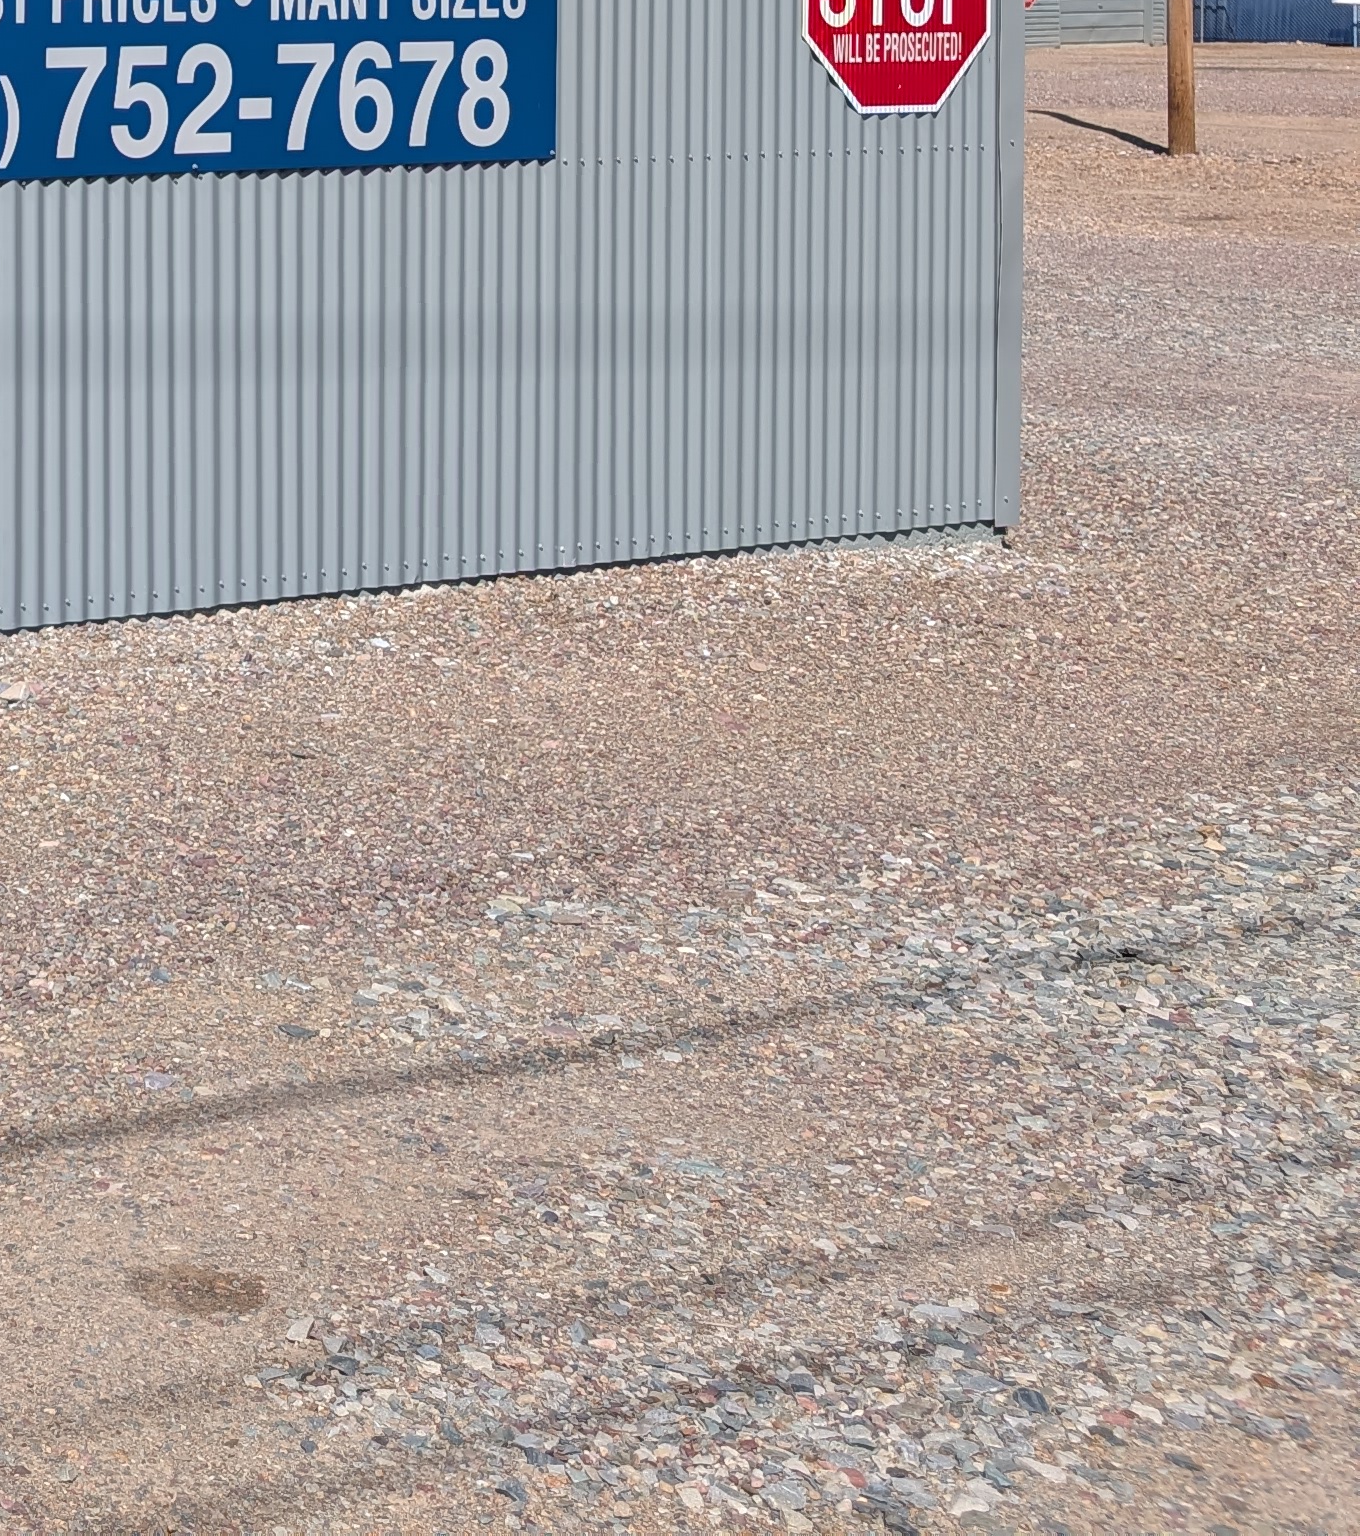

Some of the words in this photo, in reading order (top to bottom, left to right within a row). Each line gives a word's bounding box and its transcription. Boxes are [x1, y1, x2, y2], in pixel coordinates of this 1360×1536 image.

[833, 33, 862, 63] WILL
[865, 33, 880, 63] BE
[883, 31, 962, 62] PROSECUTED!
[45, 39, 511, 159] 752-7678
